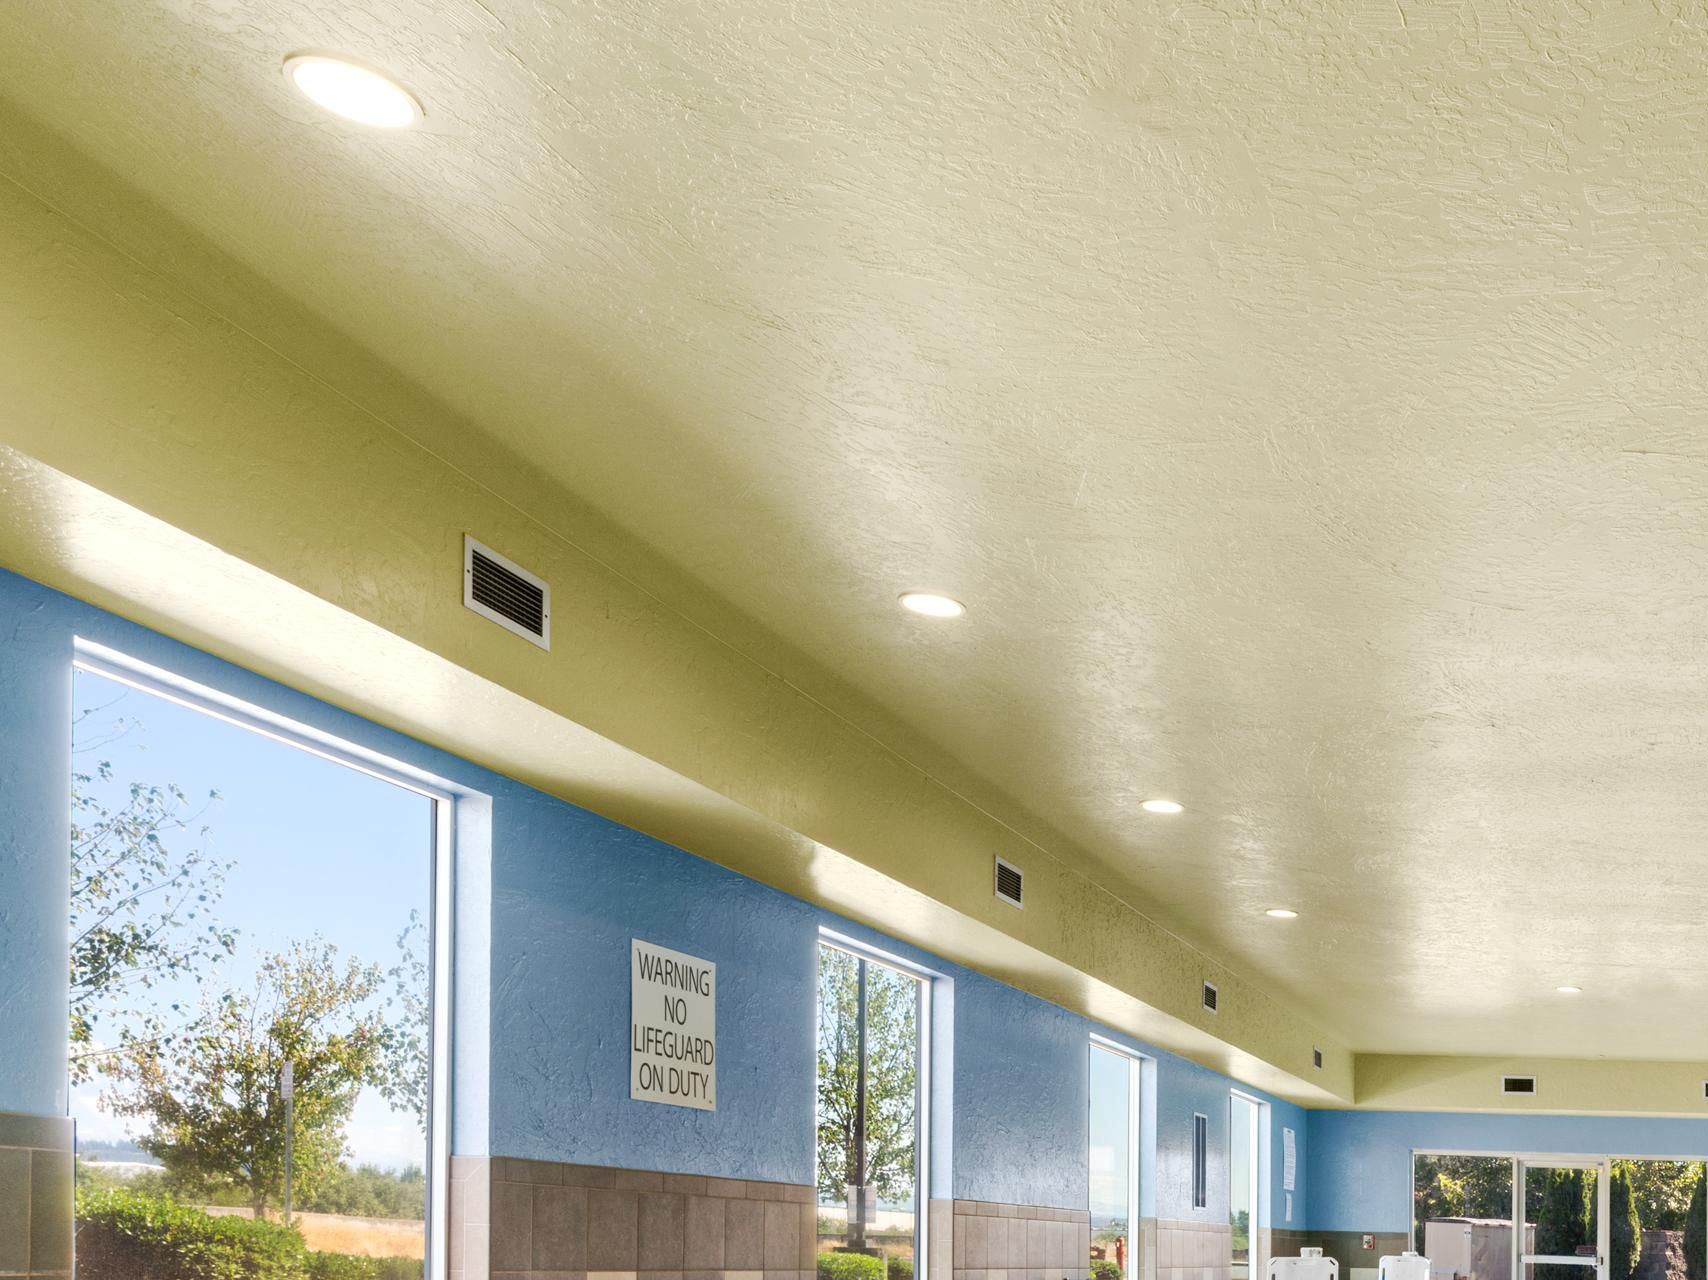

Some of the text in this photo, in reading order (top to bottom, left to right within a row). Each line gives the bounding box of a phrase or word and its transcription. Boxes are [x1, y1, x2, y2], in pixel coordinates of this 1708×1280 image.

[638, 949, 710, 997] WARNING
[664, 994, 687, 1025] NO
[633, 1023, 714, 1066] LIFEGUARD
[639, 1062, 709, 1100] ON DUTY
